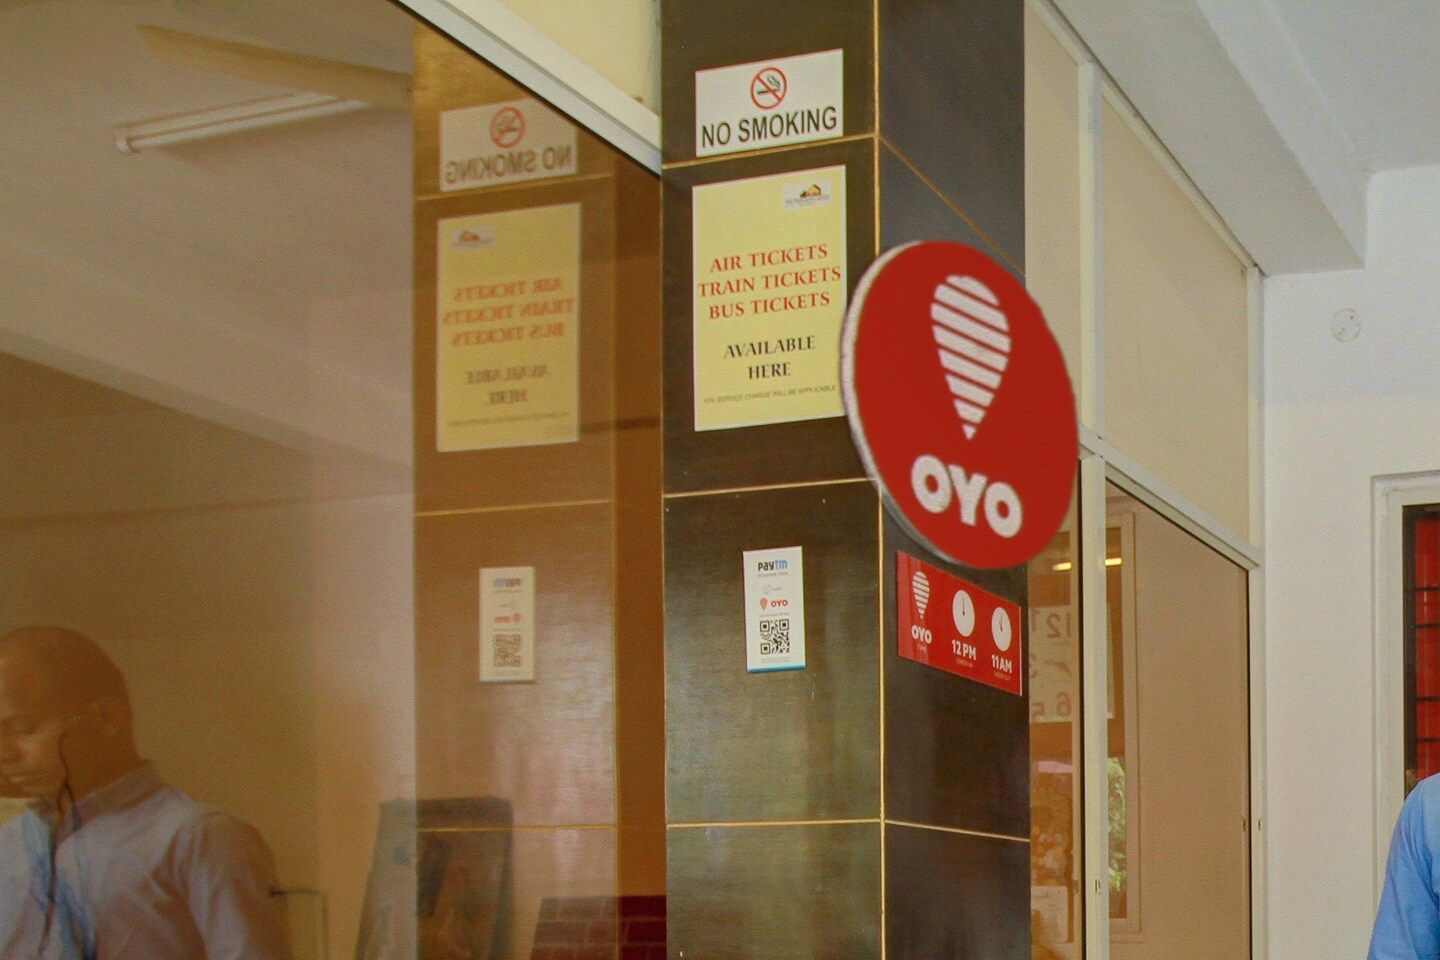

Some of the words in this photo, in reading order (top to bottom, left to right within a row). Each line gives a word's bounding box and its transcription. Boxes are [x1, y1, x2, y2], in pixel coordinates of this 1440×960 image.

[702, 122, 731, 148] NO
[738, 106, 837, 143] SMOKING
[710, 256, 742, 274] AIR
[749, 243, 828, 267] TICKETS
[699, 277, 756, 298] TRAIN
[762, 266, 842, 290] TICKETS
[709, 302, 745, 321] BUS
[751, 291, 831, 315] TICKETS
[723, 335, 815, 360] AVAILABLE
[749, 362, 792, 380] HERE
[910, 453, 1024, 538] OYO
[770, 599, 788, 608] OYO
[911, 624, 933, 645] OYO
[951, 639, 962, 656] 12
[962, 642, 977, 661] PM
